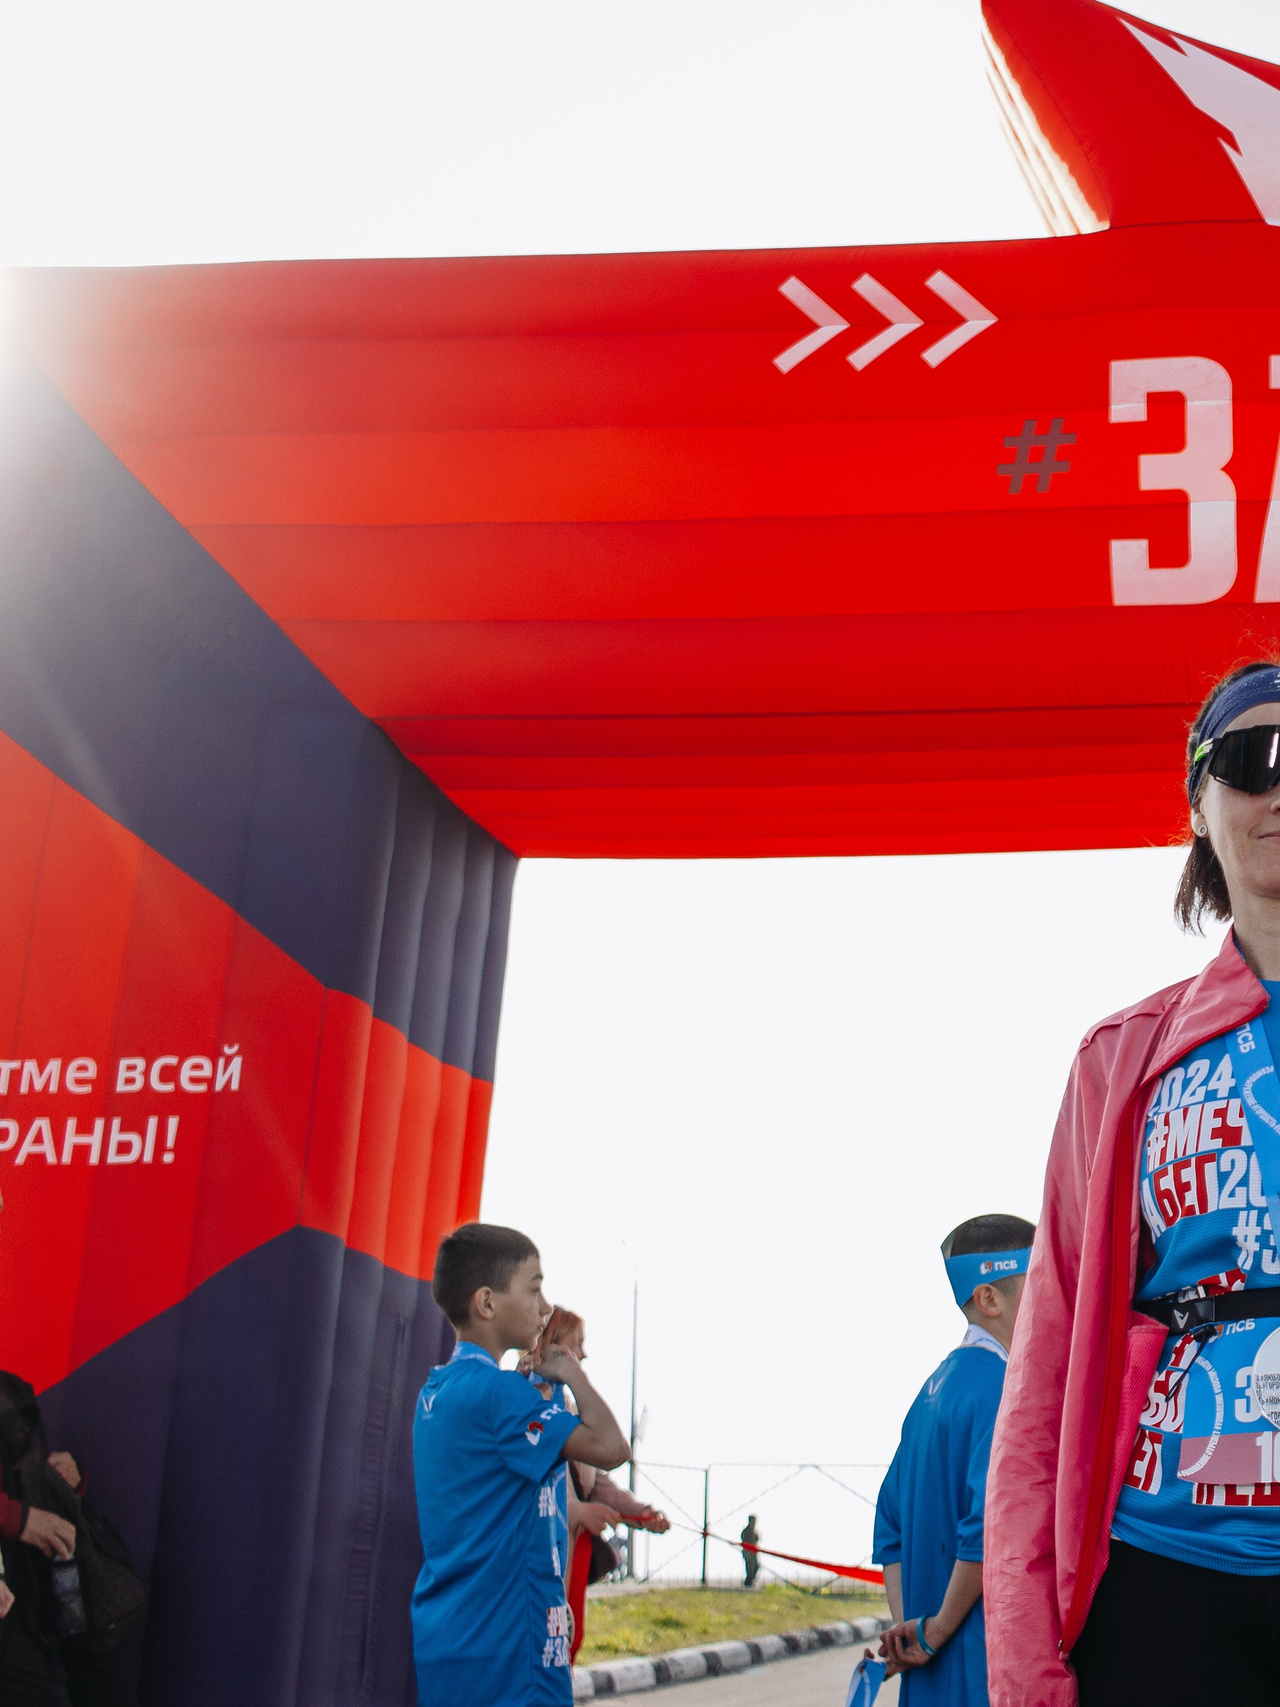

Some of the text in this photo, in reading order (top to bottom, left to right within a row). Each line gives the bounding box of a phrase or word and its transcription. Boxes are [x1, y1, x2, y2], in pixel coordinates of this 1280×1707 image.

[116, 1043, 243, 1094] всей
[994, 1260, 1018, 1271] ПСБ
[1226, 1318, 1256, 1335] ПСБ
